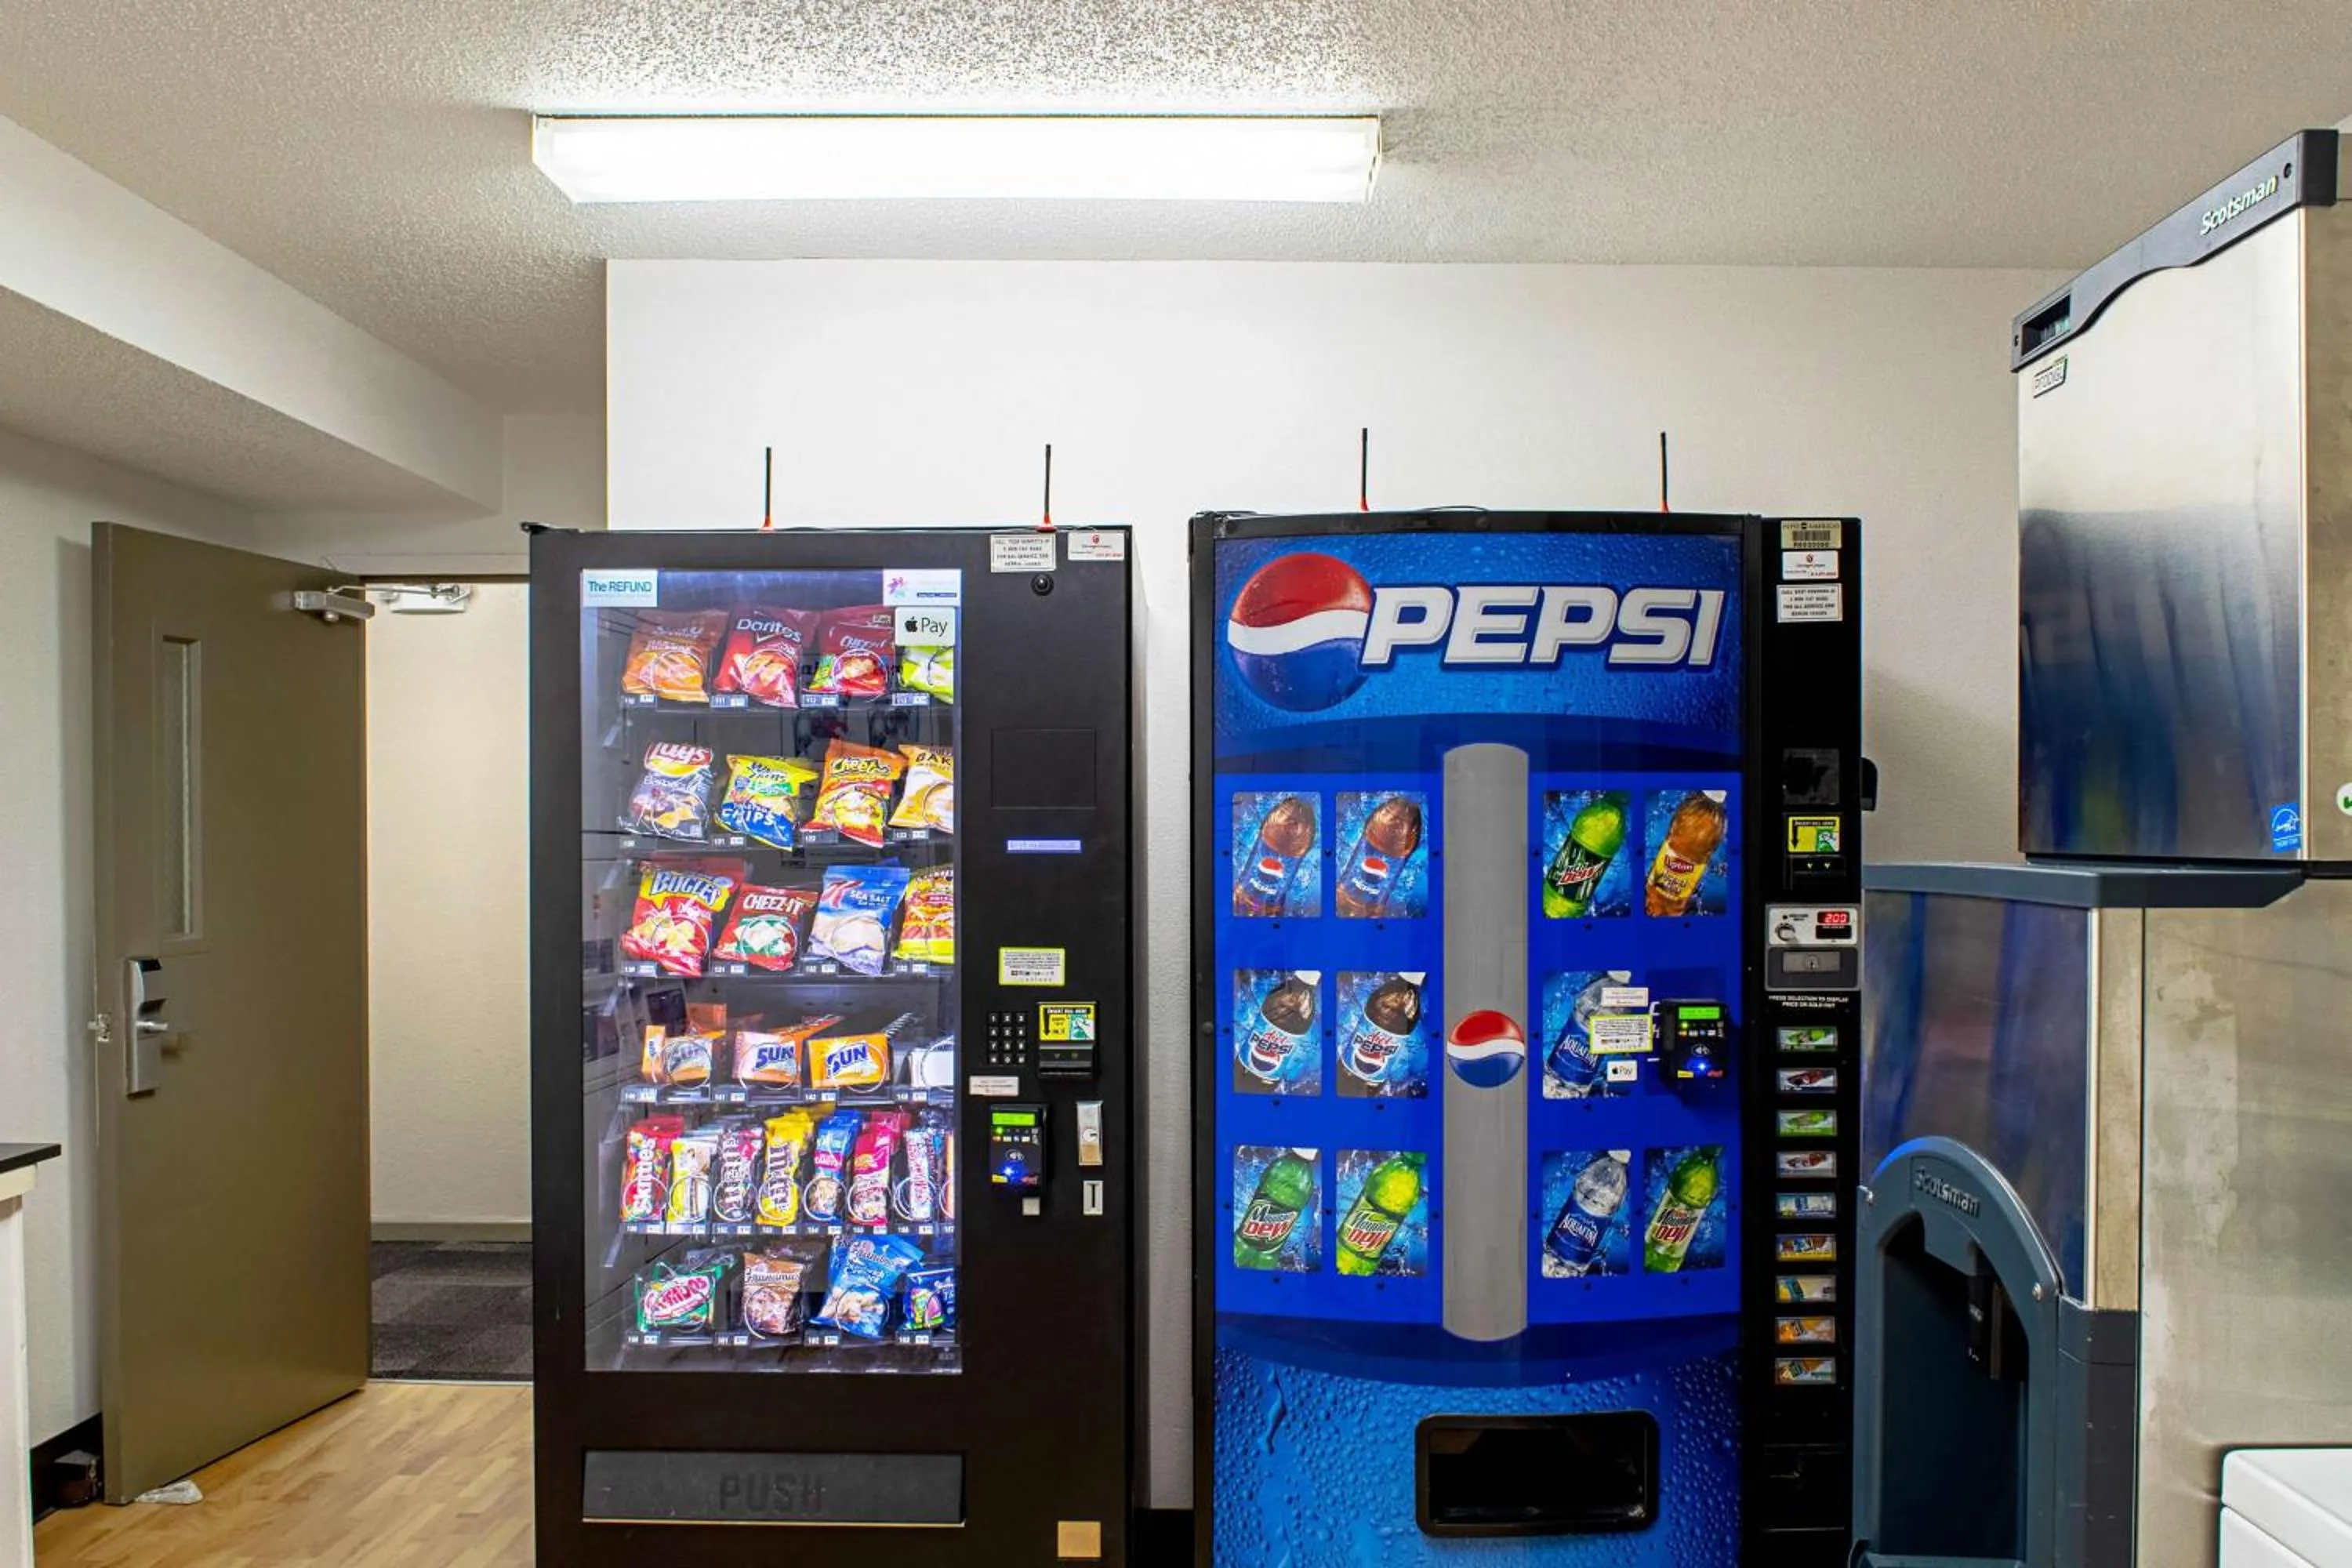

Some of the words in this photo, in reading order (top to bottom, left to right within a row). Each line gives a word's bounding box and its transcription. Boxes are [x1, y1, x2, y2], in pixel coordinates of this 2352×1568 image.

[2200, 175, 2278, 235] Scotsman
[588, 580, 607, 592] The
[609, 580, 652, 592] REFUND
[736, 617, 803, 642] Doritos
[921, 617, 947, 637] Pay
[1361, 586, 1725, 665] PEPSI
[721, 807, 775, 826] CHIPS
[849, 888, 868, 901] SEA
[869, 893, 891, 903] SALT
[1250, 1033, 1292, 1054] PEPSI
[1354, 1033, 1399, 1054] PEPSI
[755, 1046, 794, 1069] SUN
[827, 1044, 867, 1074] SUN
[1618, 1066, 1632, 1077] Pay
[1915, 1166, 1980, 1216] Scotsman
[1559, 1213, 1599, 1247] AQUAFINA
[718, 1473, 825, 1512] PUSH
